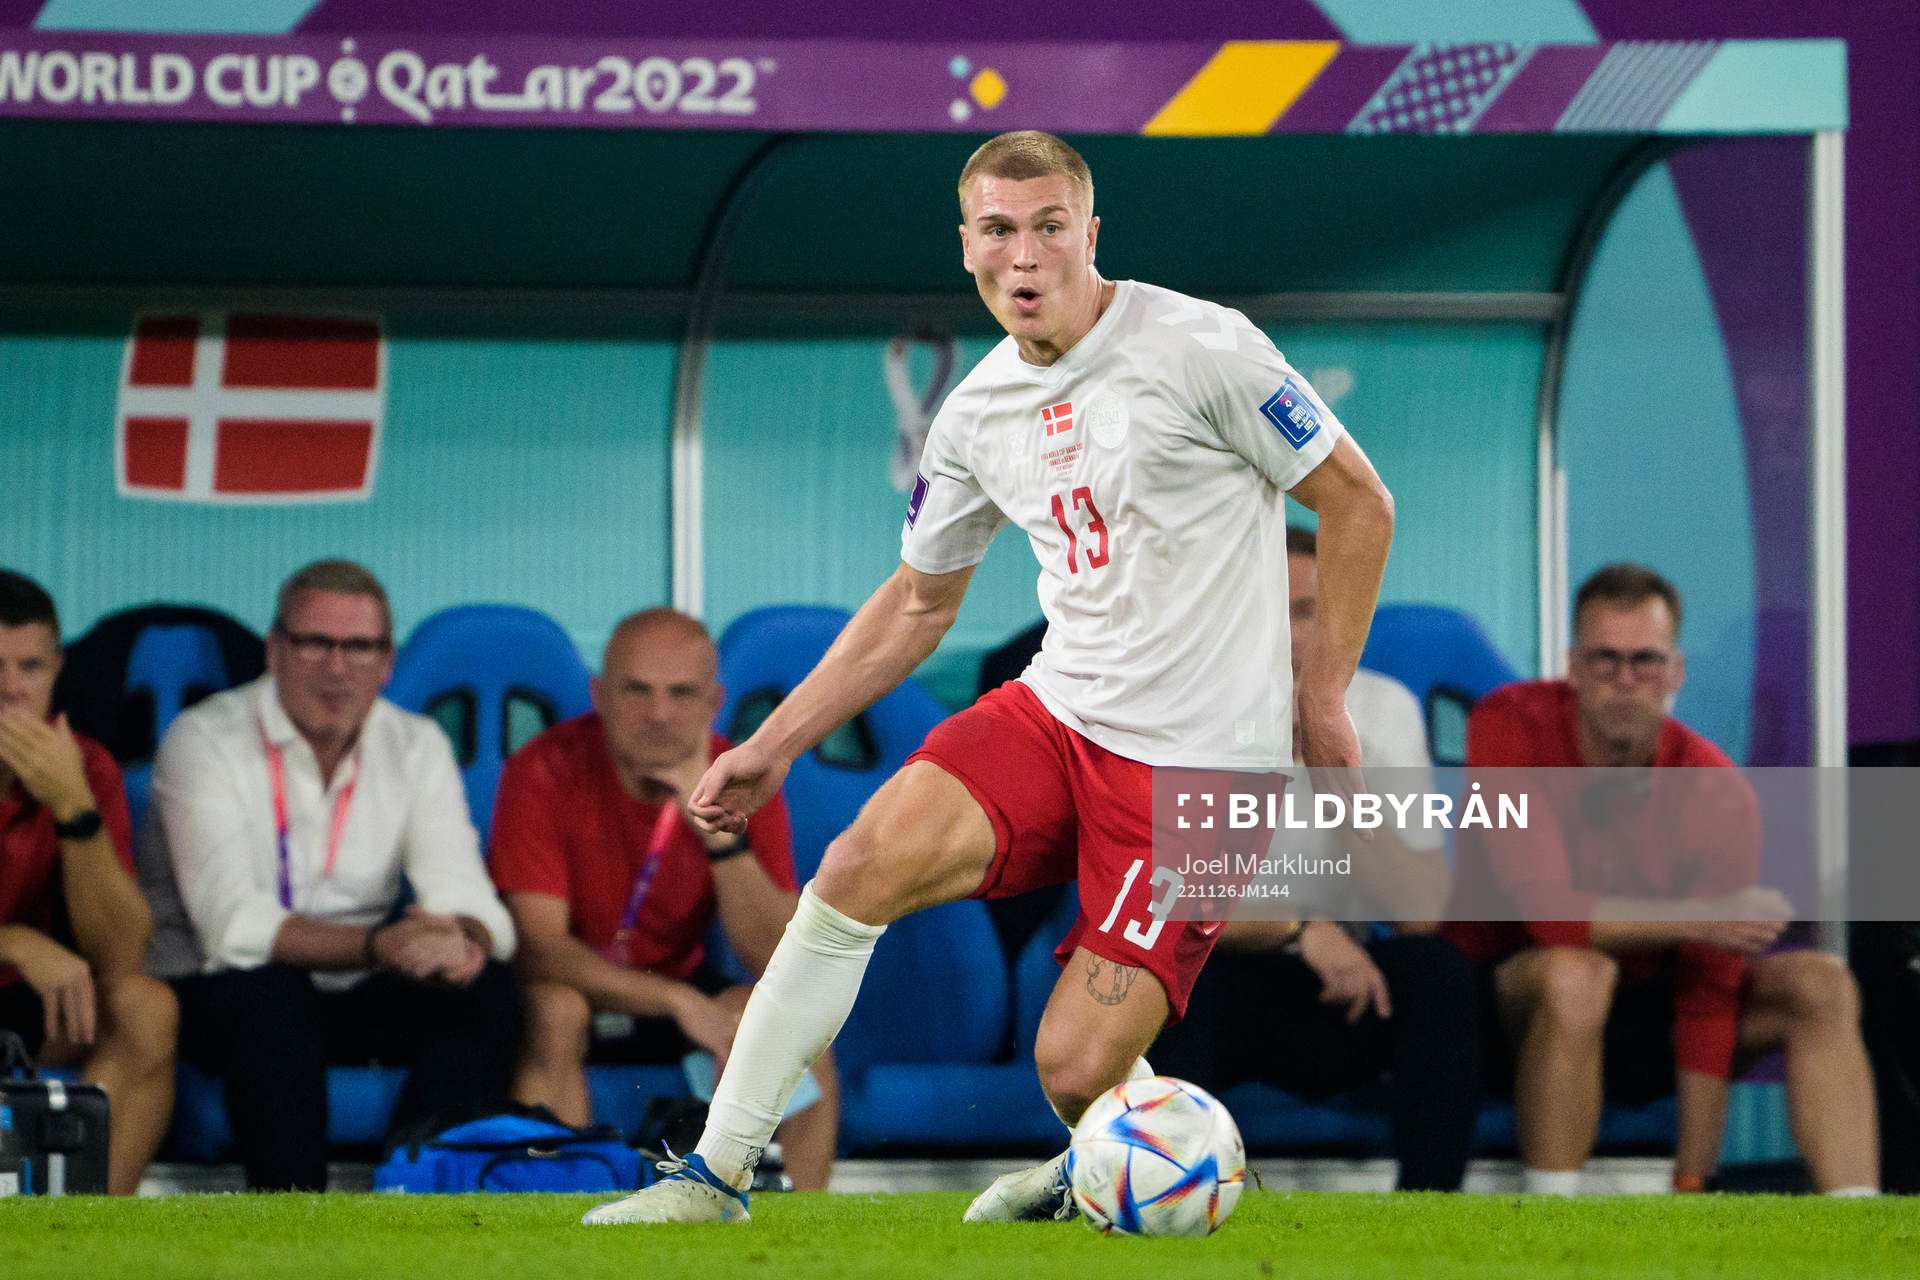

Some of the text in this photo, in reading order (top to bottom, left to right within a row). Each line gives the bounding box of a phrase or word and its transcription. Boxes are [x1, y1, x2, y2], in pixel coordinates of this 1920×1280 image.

[0, 50, 197, 103] WORLD
[203, 53, 321, 107] CUP
[1051, 486, 1109, 574] 13
[1098, 858, 1185, 951] 13
